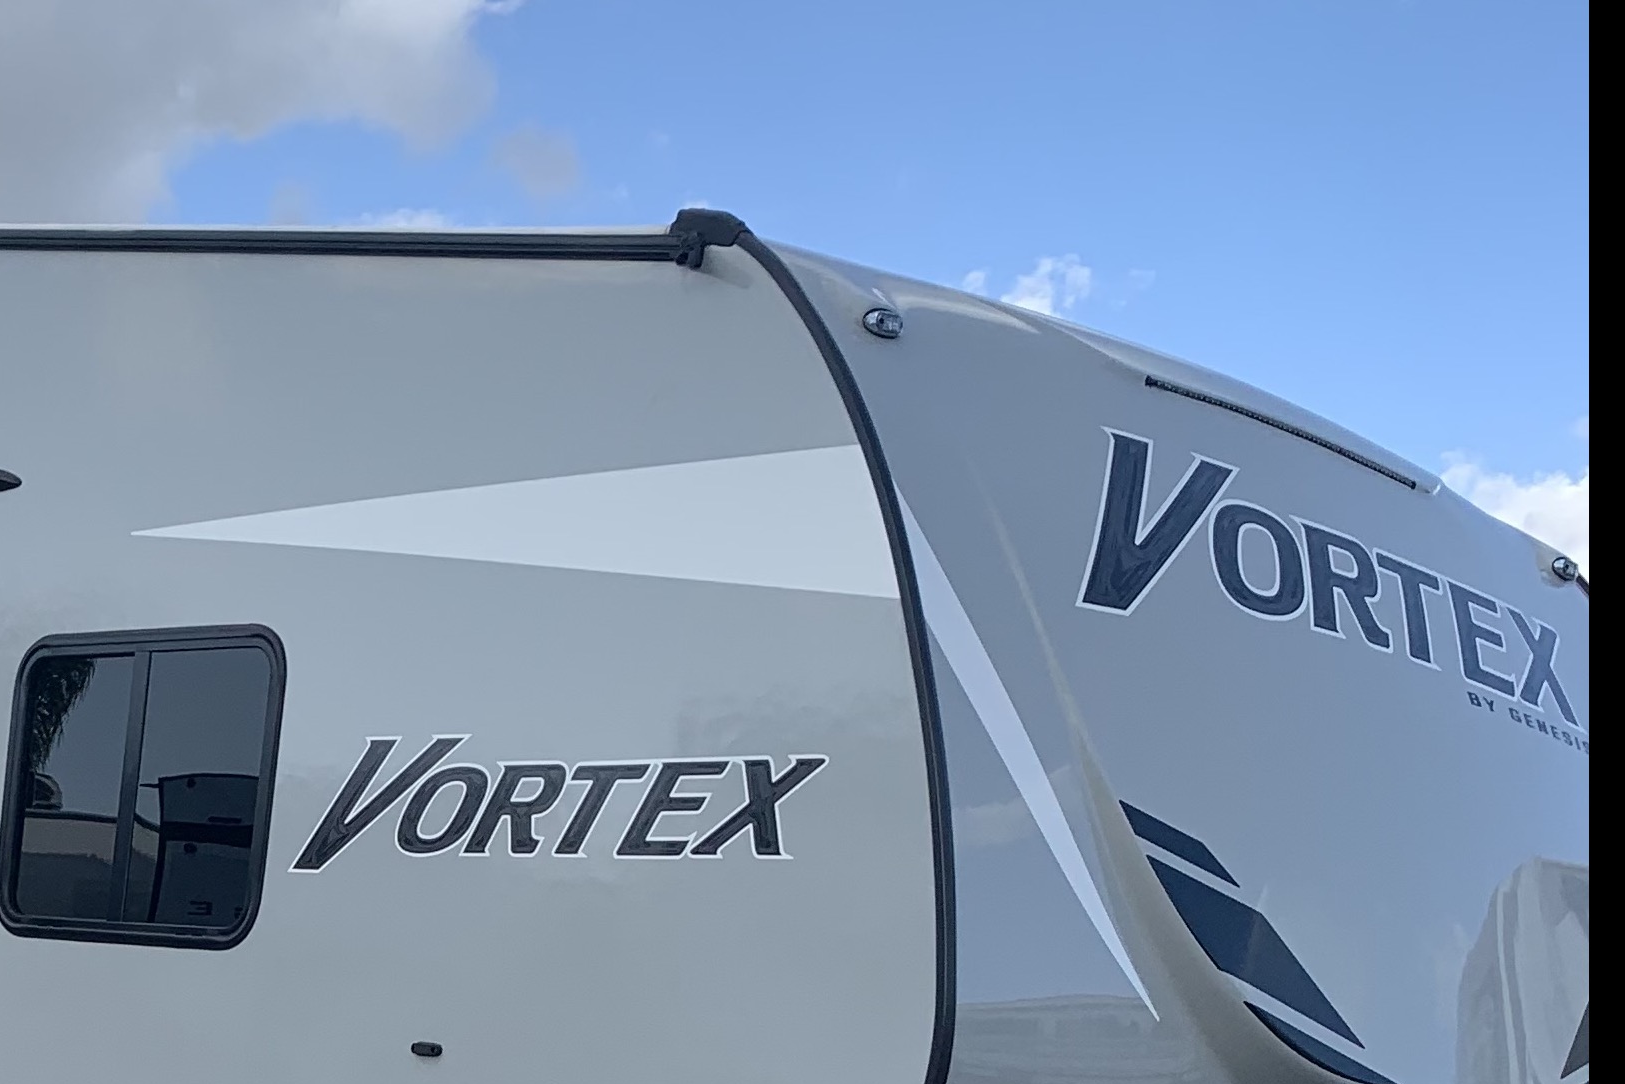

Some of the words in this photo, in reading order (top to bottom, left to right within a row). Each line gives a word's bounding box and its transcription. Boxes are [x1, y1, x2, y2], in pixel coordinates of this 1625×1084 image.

[1075, 425, 1585, 734] VORTEX
[1467, 691, 1495, 712] BY
[287, 733, 829, 873] VORTEX
